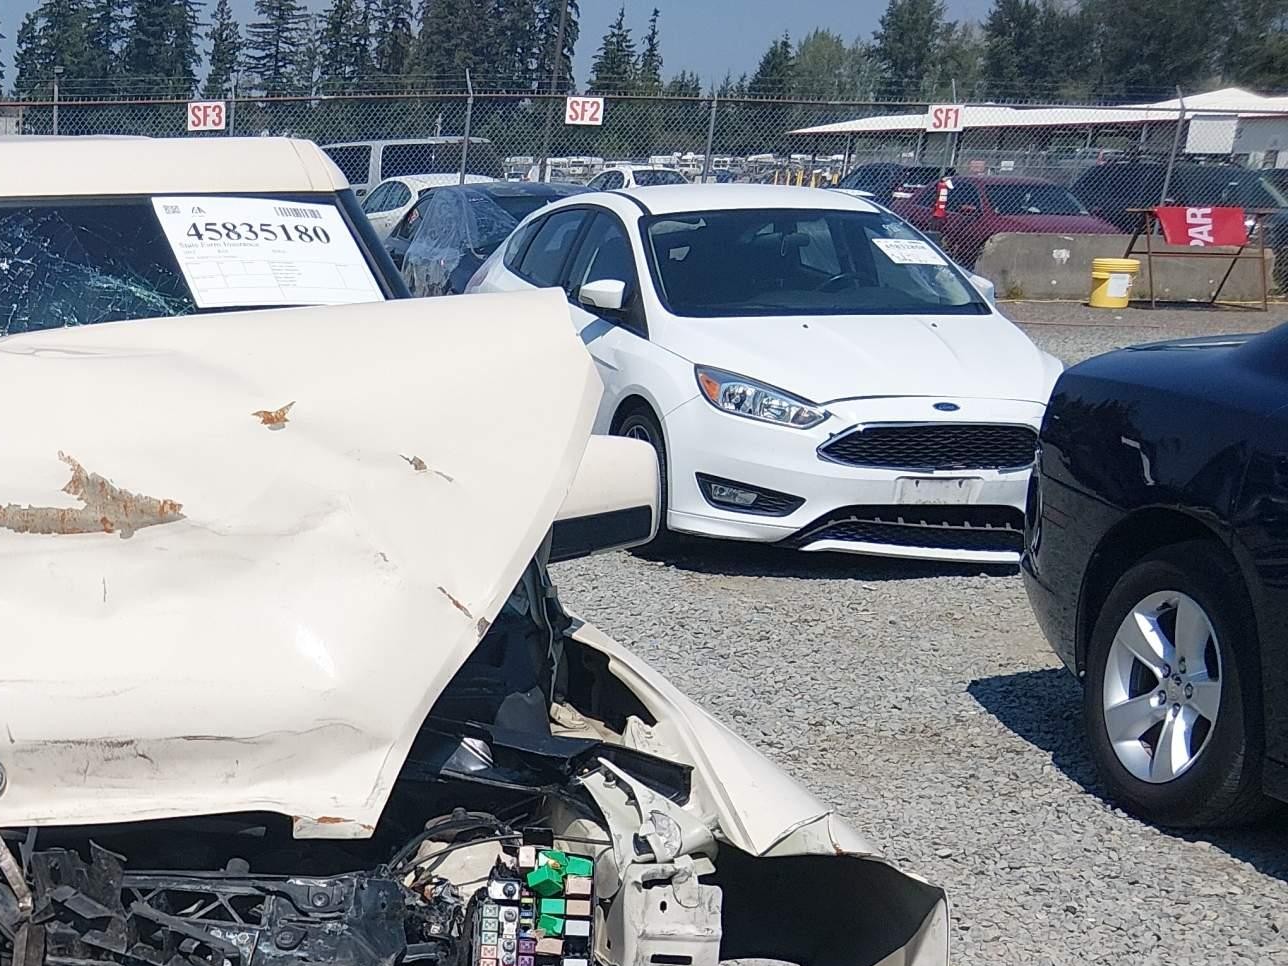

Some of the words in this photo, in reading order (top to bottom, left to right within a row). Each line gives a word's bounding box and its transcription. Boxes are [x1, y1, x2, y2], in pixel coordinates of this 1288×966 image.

[191, 104, 223, 127] SF3
[568, 100, 601, 121] SF2
[932, 107, 960, 128] SF1
[186, 222, 331, 244] 45835180
